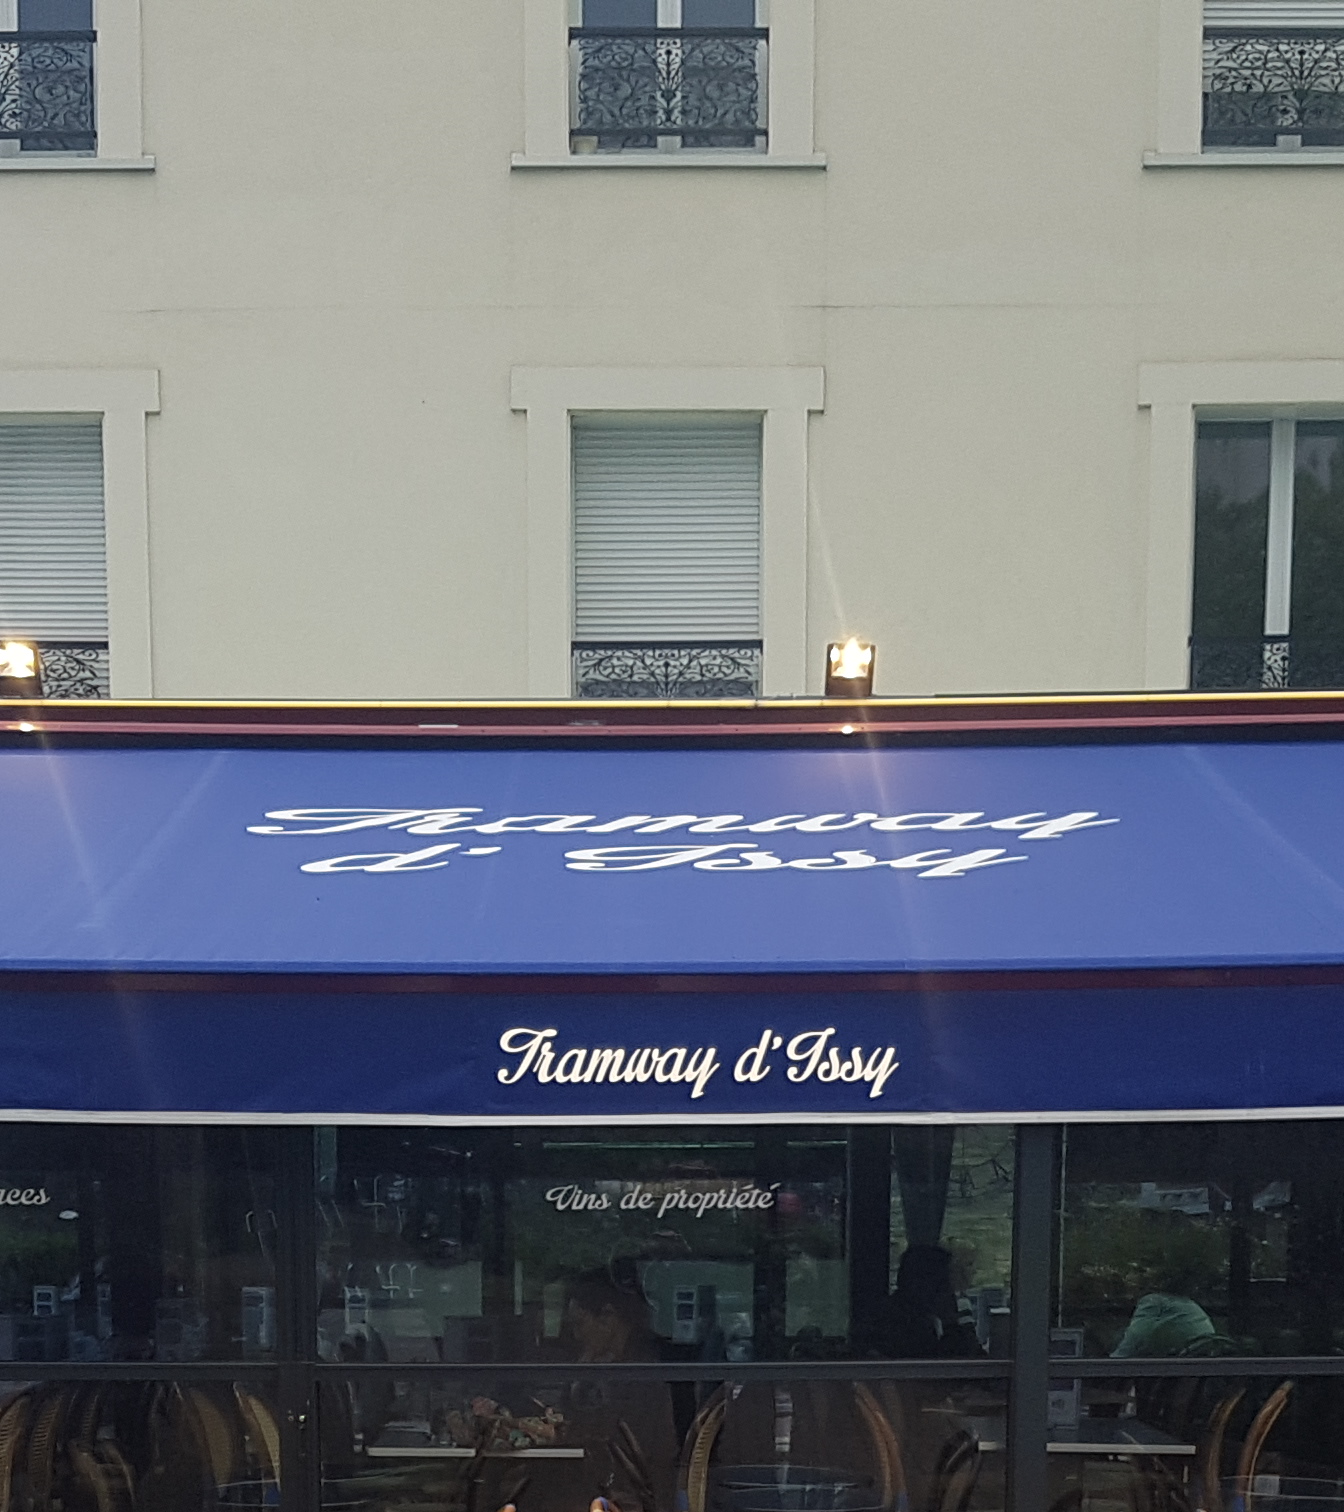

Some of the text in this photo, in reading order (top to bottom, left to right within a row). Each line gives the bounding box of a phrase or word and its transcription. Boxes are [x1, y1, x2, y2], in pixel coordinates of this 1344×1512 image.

[245, 807, 1121, 839] Tramway
[497, 1027, 720, 1099] Tramway
[545, 1182, 782, 1218] Vins de propriété
